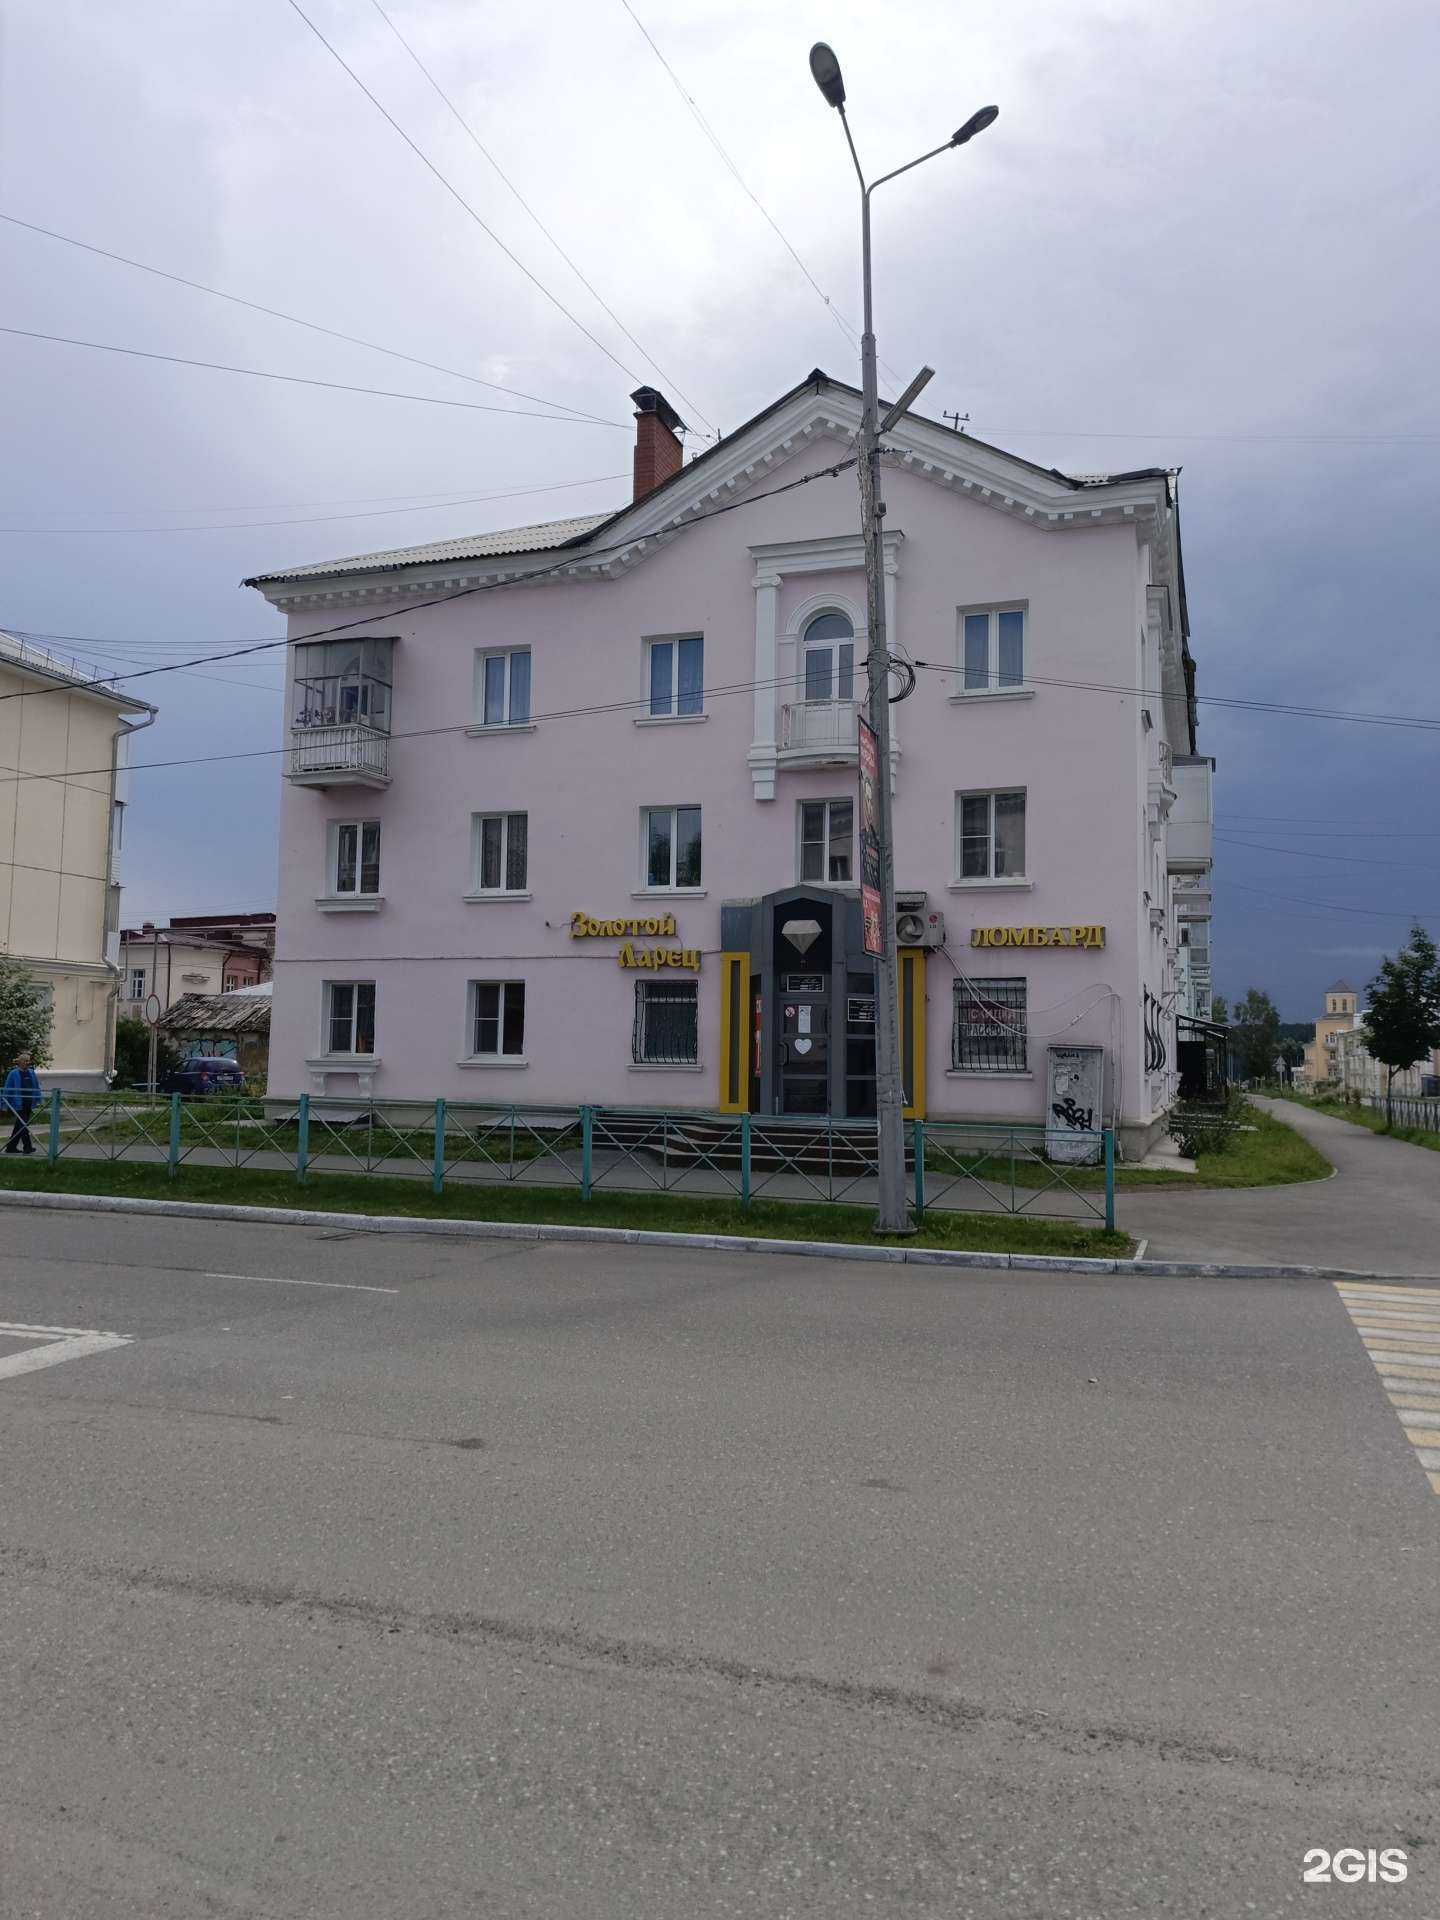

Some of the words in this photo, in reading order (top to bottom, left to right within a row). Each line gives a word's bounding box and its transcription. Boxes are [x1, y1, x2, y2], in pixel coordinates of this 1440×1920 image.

[570, 911, 677, 938] Золотой
[971, 926, 1104, 949] ЛОМБАРД
[618, 942, 701, 972] Ларец
